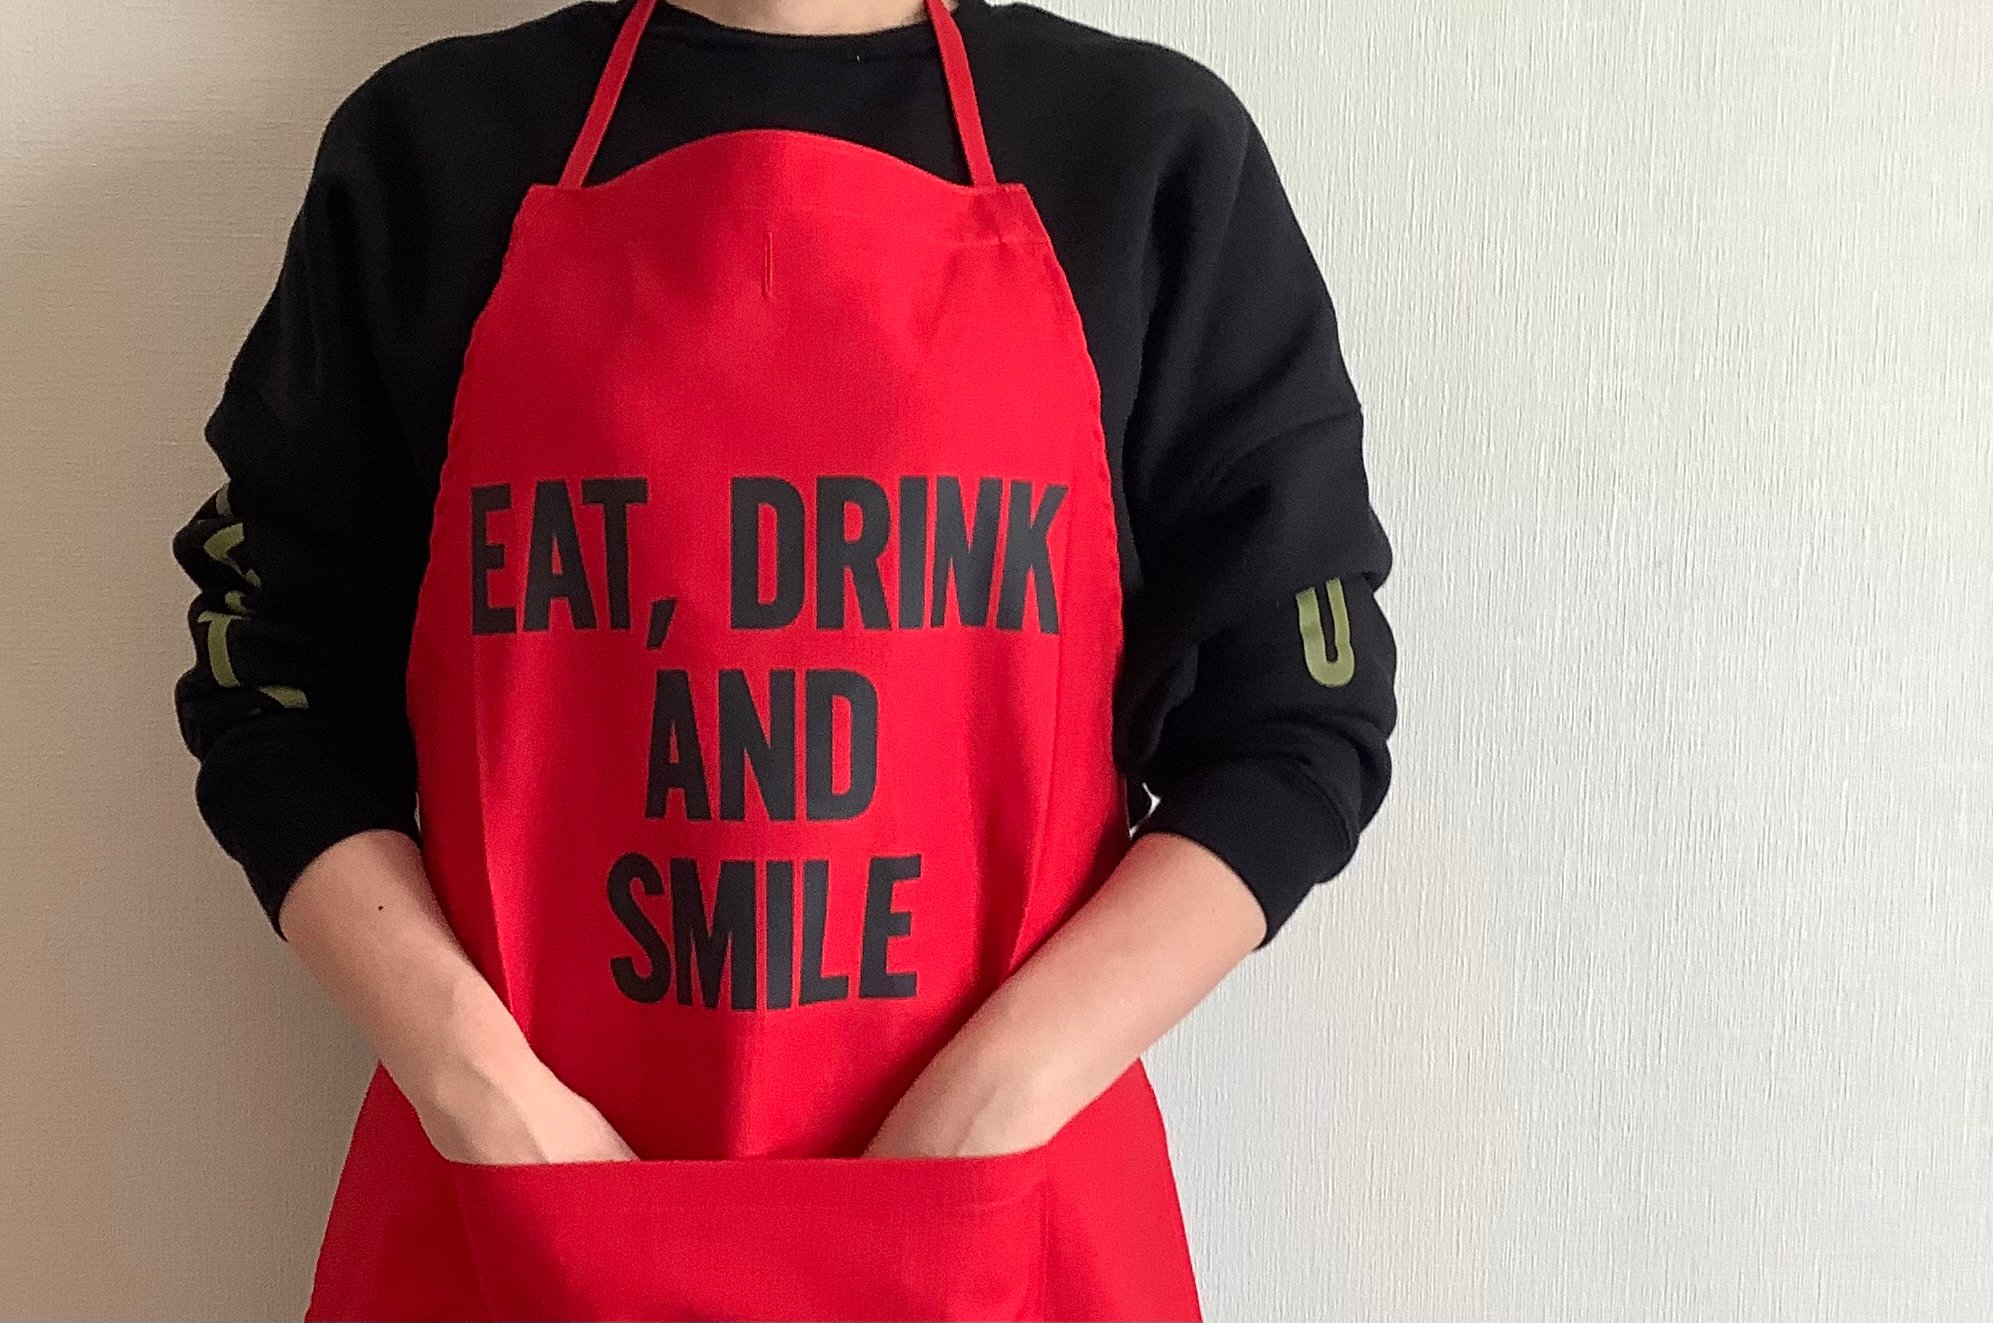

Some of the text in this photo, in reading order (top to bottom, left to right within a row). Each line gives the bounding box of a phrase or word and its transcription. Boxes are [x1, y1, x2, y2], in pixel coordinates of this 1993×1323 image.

[469, 477, 677, 650] EAT,
[730, 476, 1068, 636] DRINK
[644, 668, 878, 823] AND
[606, 851, 921, 1012] SMILE
